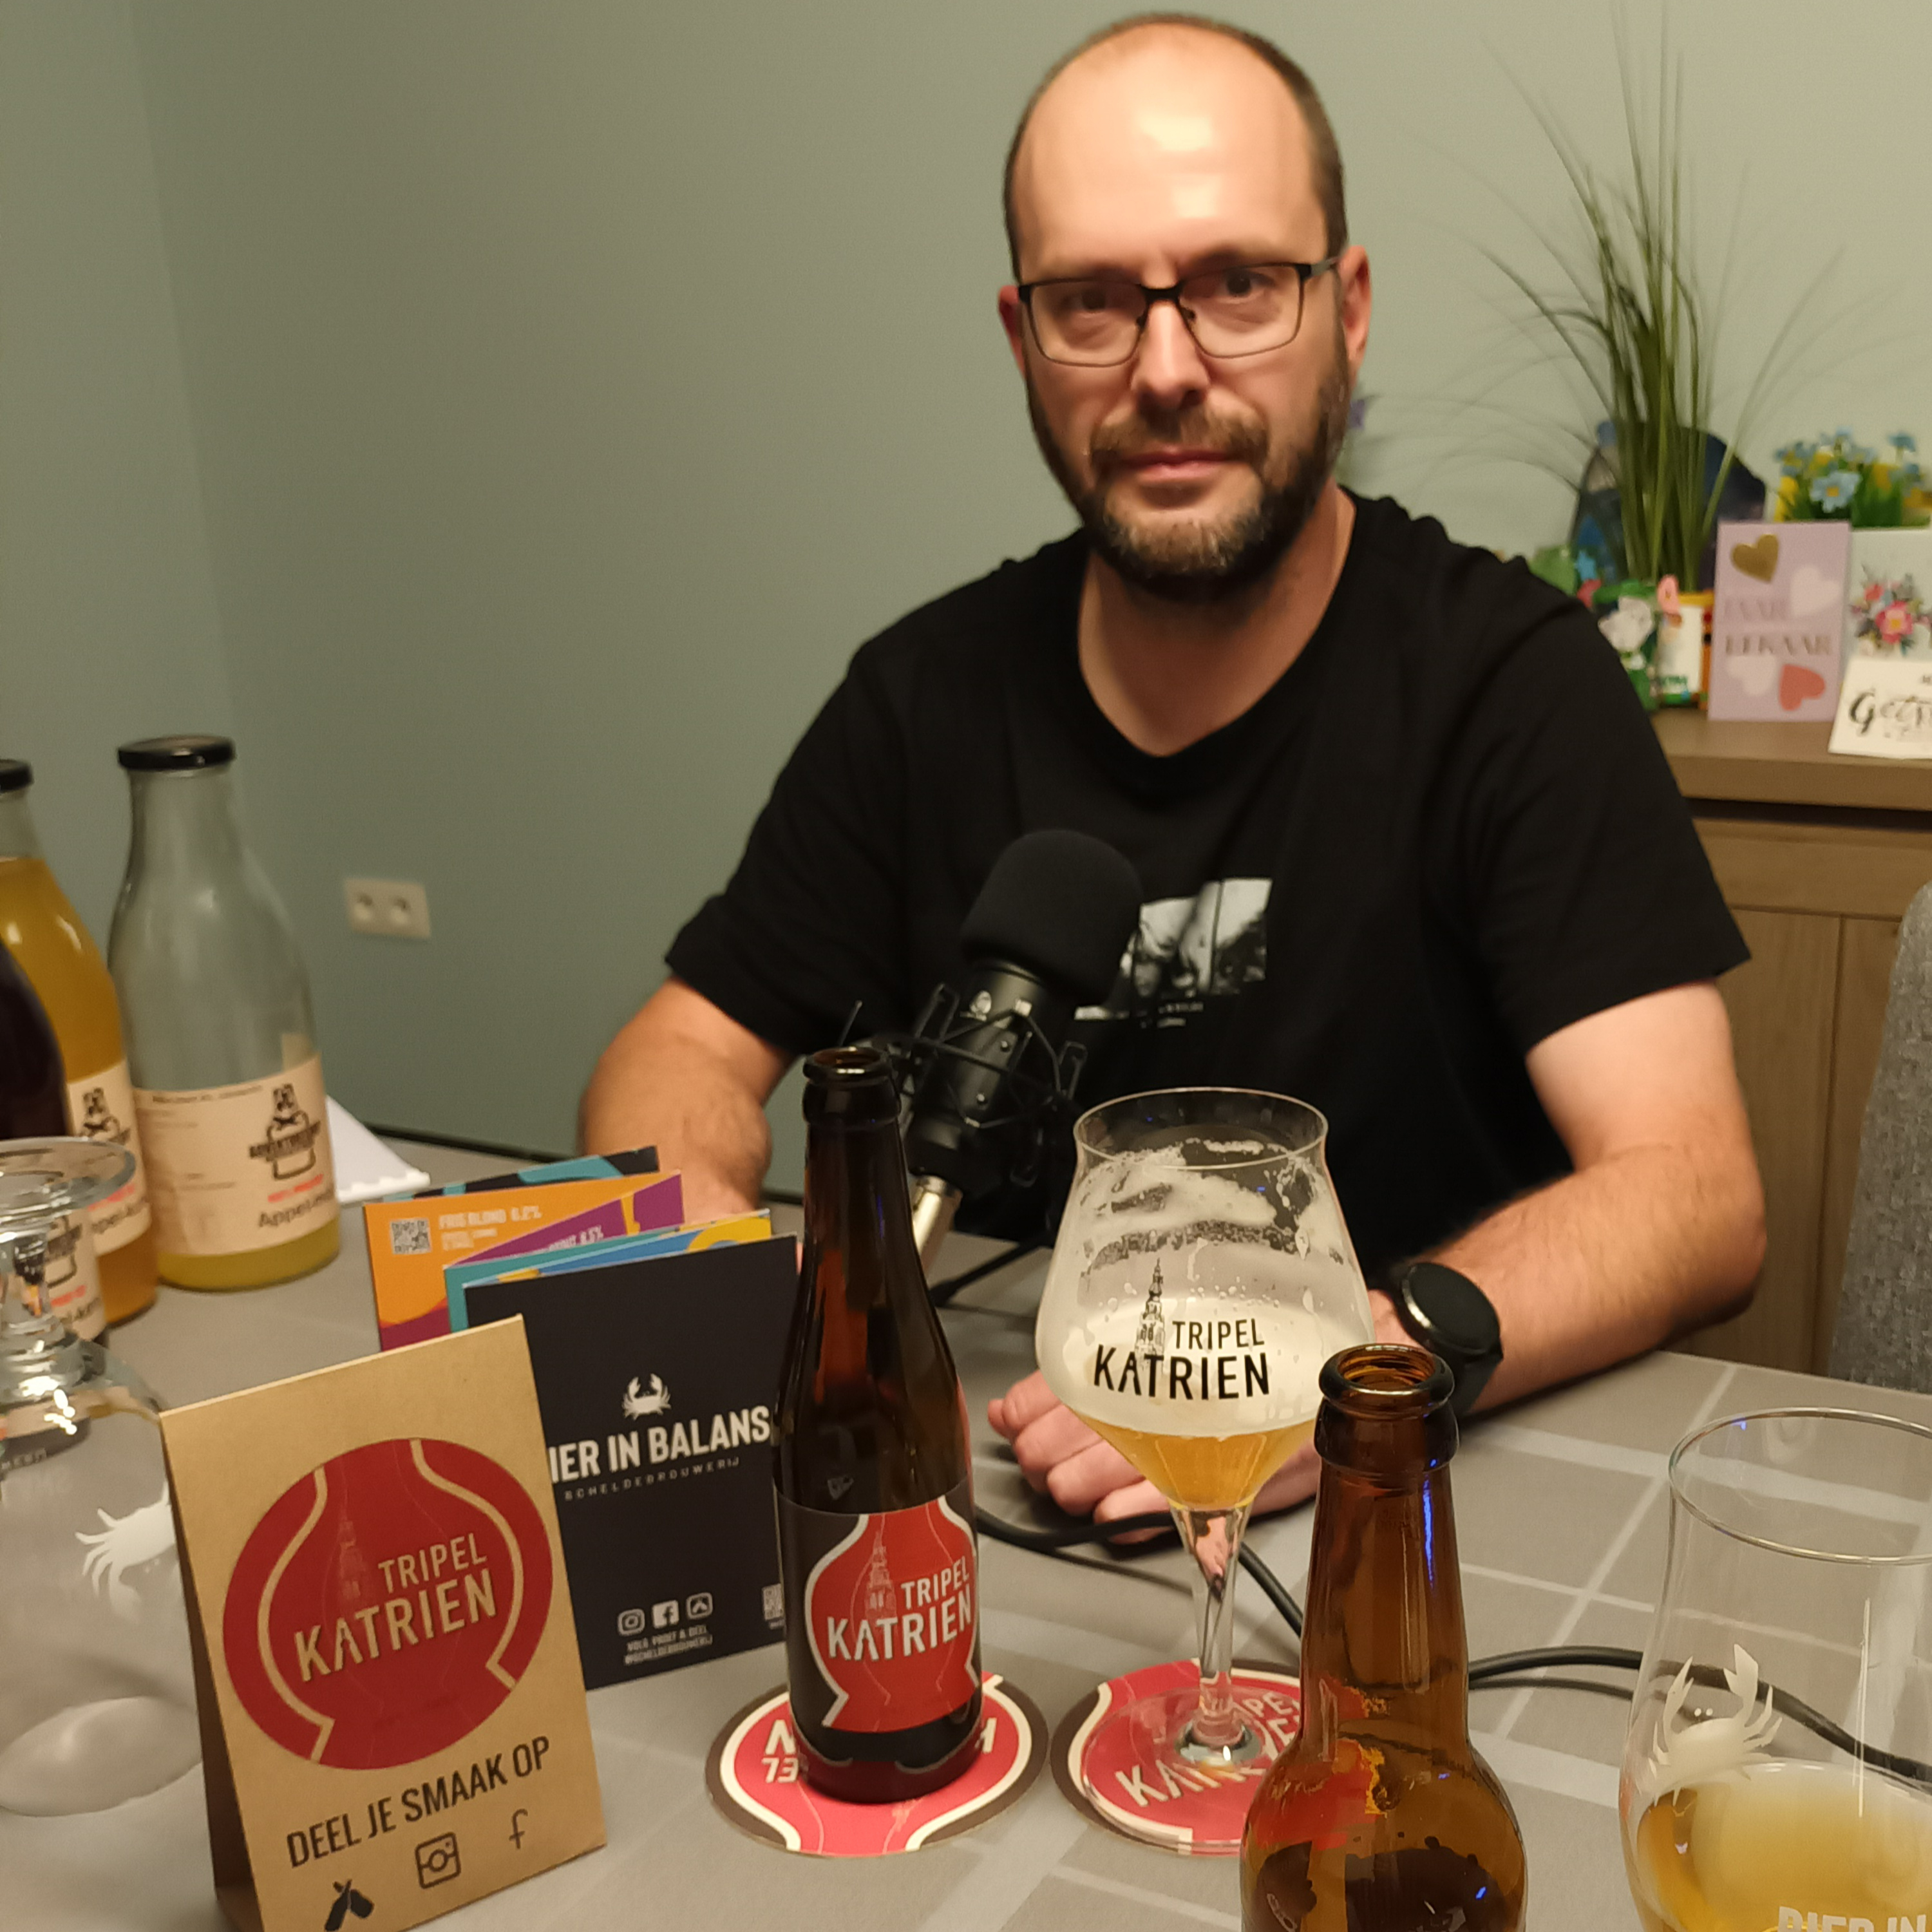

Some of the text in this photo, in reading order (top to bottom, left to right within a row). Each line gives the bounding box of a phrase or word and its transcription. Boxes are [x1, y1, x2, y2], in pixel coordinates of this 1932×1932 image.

[1172, 1318, 1265, 1350] TRIPEL
[1094, 1345, 1269, 1400] KATRIEN
[549, 1405, 771, 1484] IER IN BALANS
[378, 1533, 487, 1594] TRIPEL
[900, 1555, 969, 1609] TRIPEL
[293, 1568, 496, 1682] KATRIEN
[827, 1584, 971, 1661] KATRIEN
[287, 1736, 549, 1868] DEEL JE SMAAK OP
